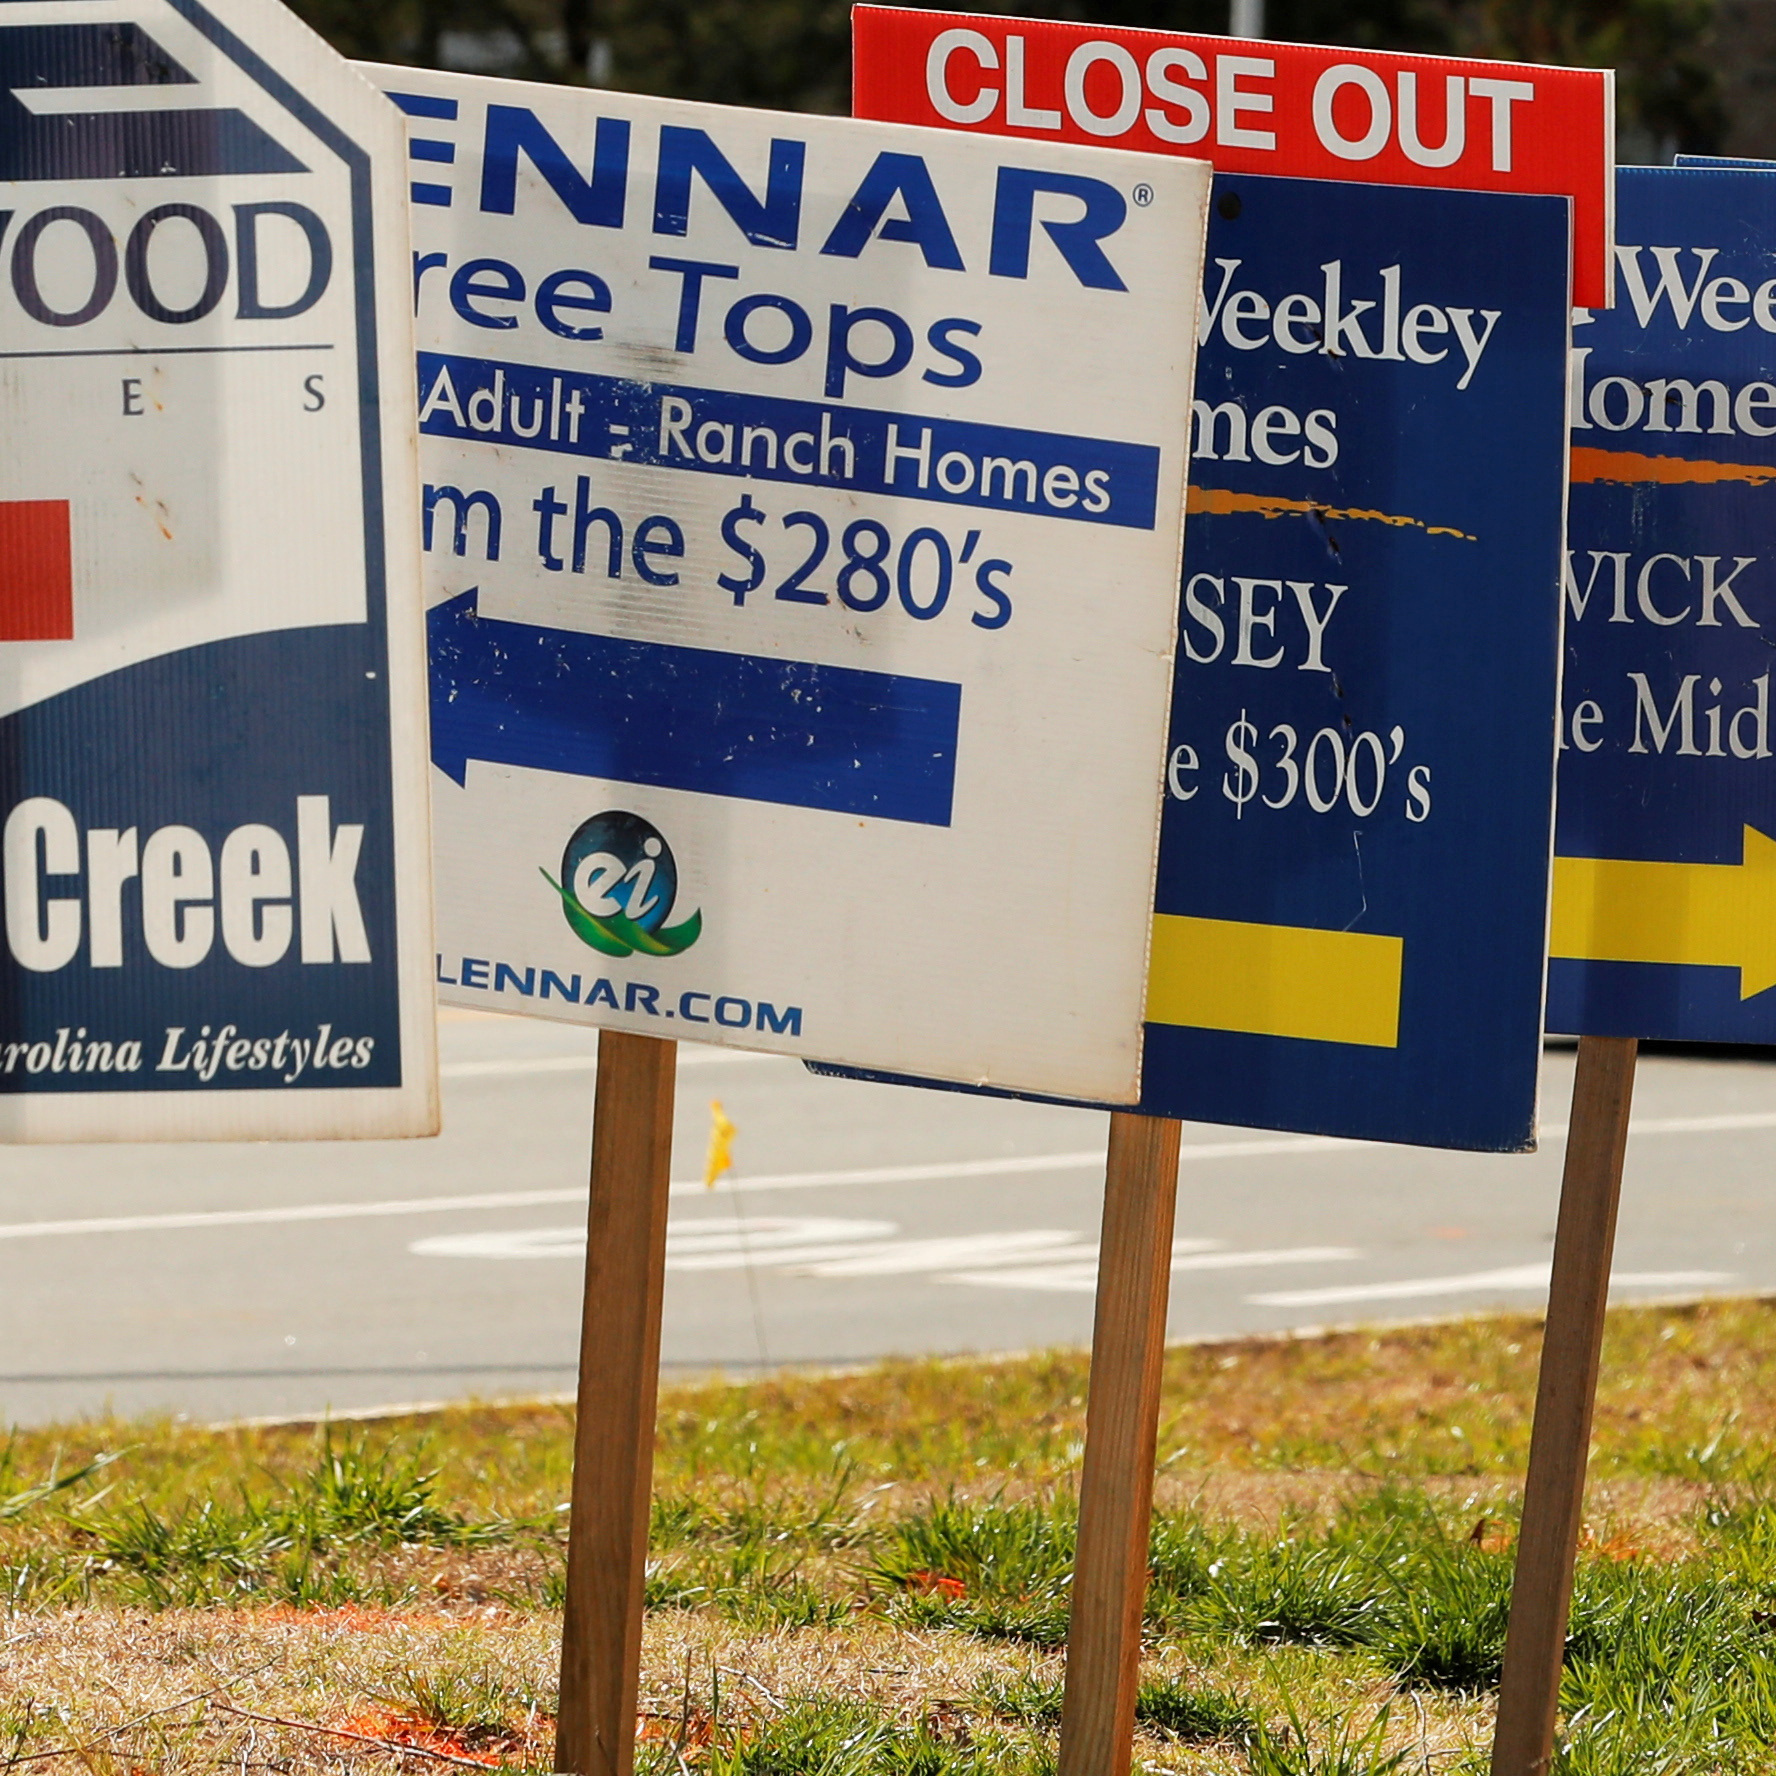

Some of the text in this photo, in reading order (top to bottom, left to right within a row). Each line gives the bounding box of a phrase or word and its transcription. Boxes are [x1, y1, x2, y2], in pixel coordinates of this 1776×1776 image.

[926, 28, 1534, 173] CLOSE OUT
[412, 249, 983, 397] ree Tops
[418, 364, 586, 443] Adult
[658, 394, 855, 481] Ranch
[885, 424, 1111, 514] Homes
[532, 473, 686, 587] the
[717, 493, 1014, 630] $280's
[1183, 572, 1350, 673] SEY
[1222, 708, 1433, 823] $300's
[1560, 696, 1605, 753] e
[1627, 671, 1773, 760] Mid
[2, 794, 372, 974] Creek
[155, 1024, 375, 1084] Lifestyles
[436, 952, 803, 1037] LENNAR.COM
